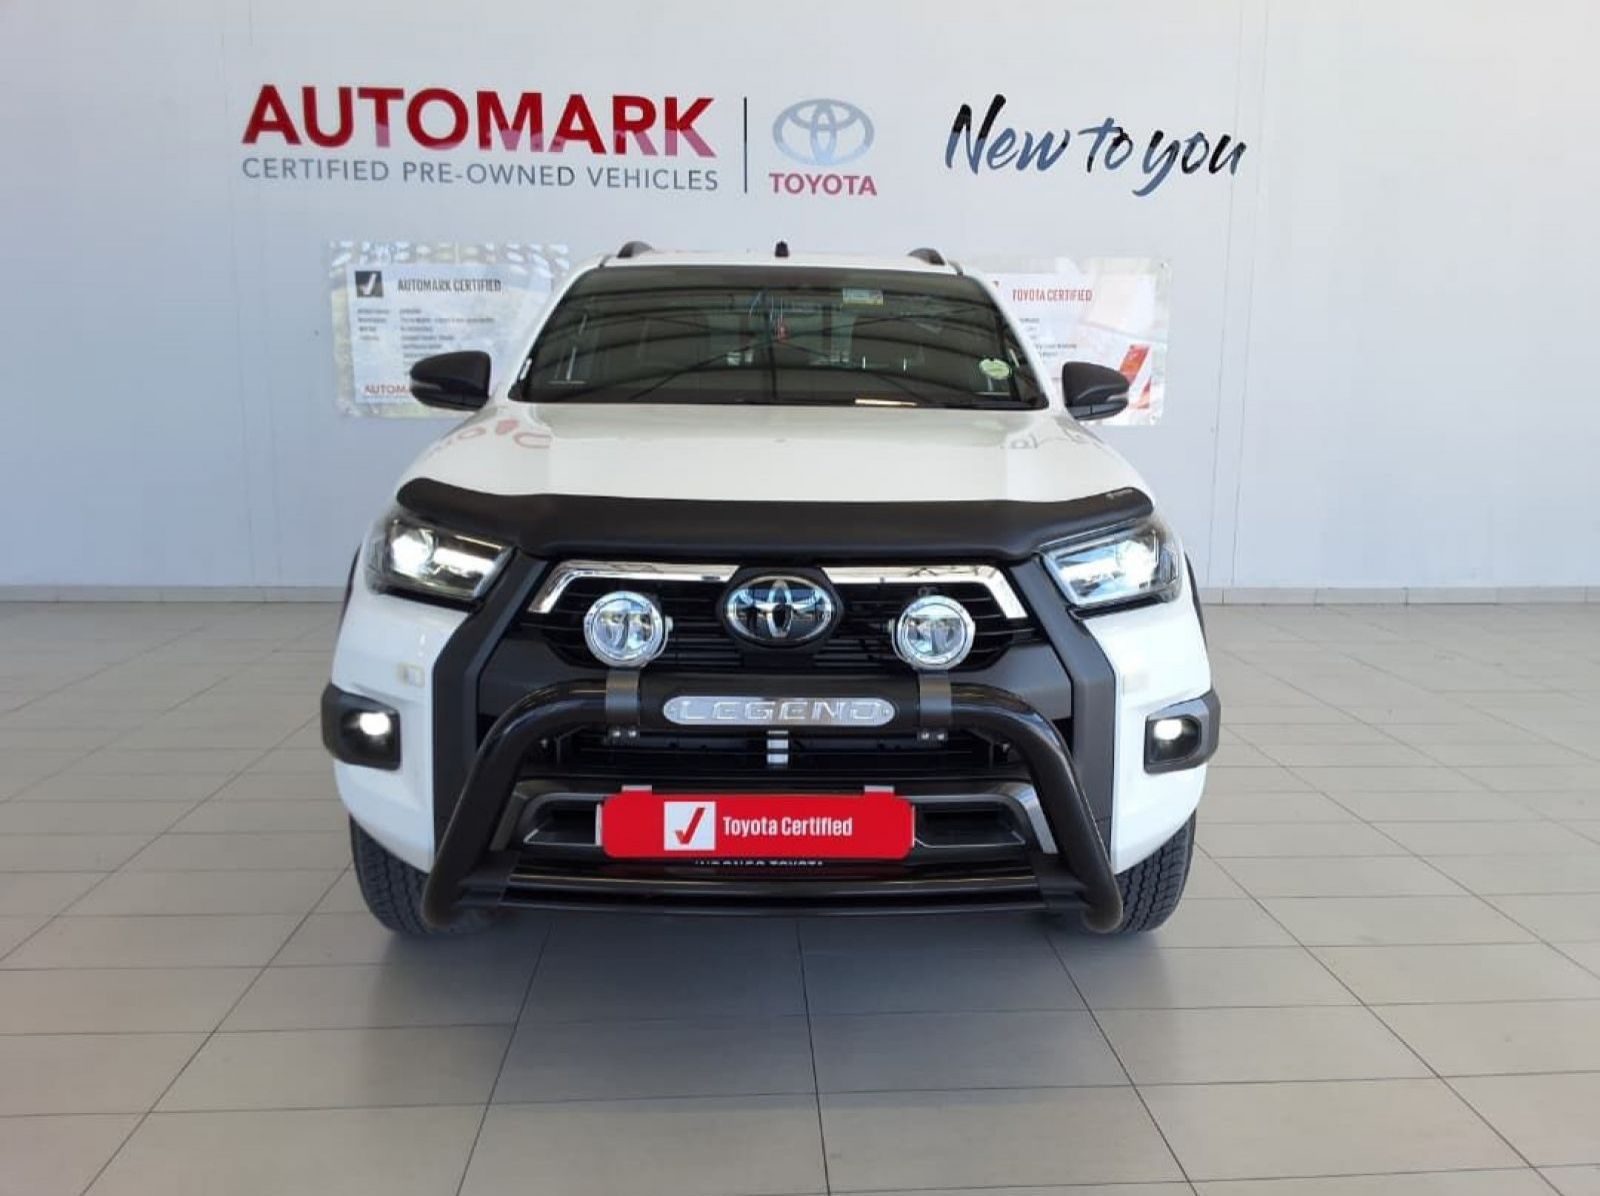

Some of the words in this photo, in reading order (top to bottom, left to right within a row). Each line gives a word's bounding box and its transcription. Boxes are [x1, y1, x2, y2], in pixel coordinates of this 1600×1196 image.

[242, 84, 717, 158] AUTOMARK
[945, 94, 1070, 174] New
[1079, 117, 1134, 173] to
[1131, 130, 1248, 197] you
[242, 157, 390, 182] CERTIFIED
[402, 161, 575, 187] PRE-OWNED
[587, 167, 718, 191] VEHICLES
[769, 173, 877, 196] TOYOTA
[398, 278, 450, 292] AUTOMARK
[452, 279, 502, 293] CERTIFIED
[1012, 288, 1045, 302] TOYOTA
[1046, 288, 1093, 302] CERTIFIED
[679, 699, 882, 721] LEGEND
[722, 816, 778, 838] Toyota
[781, 816, 853, 837] Certified
